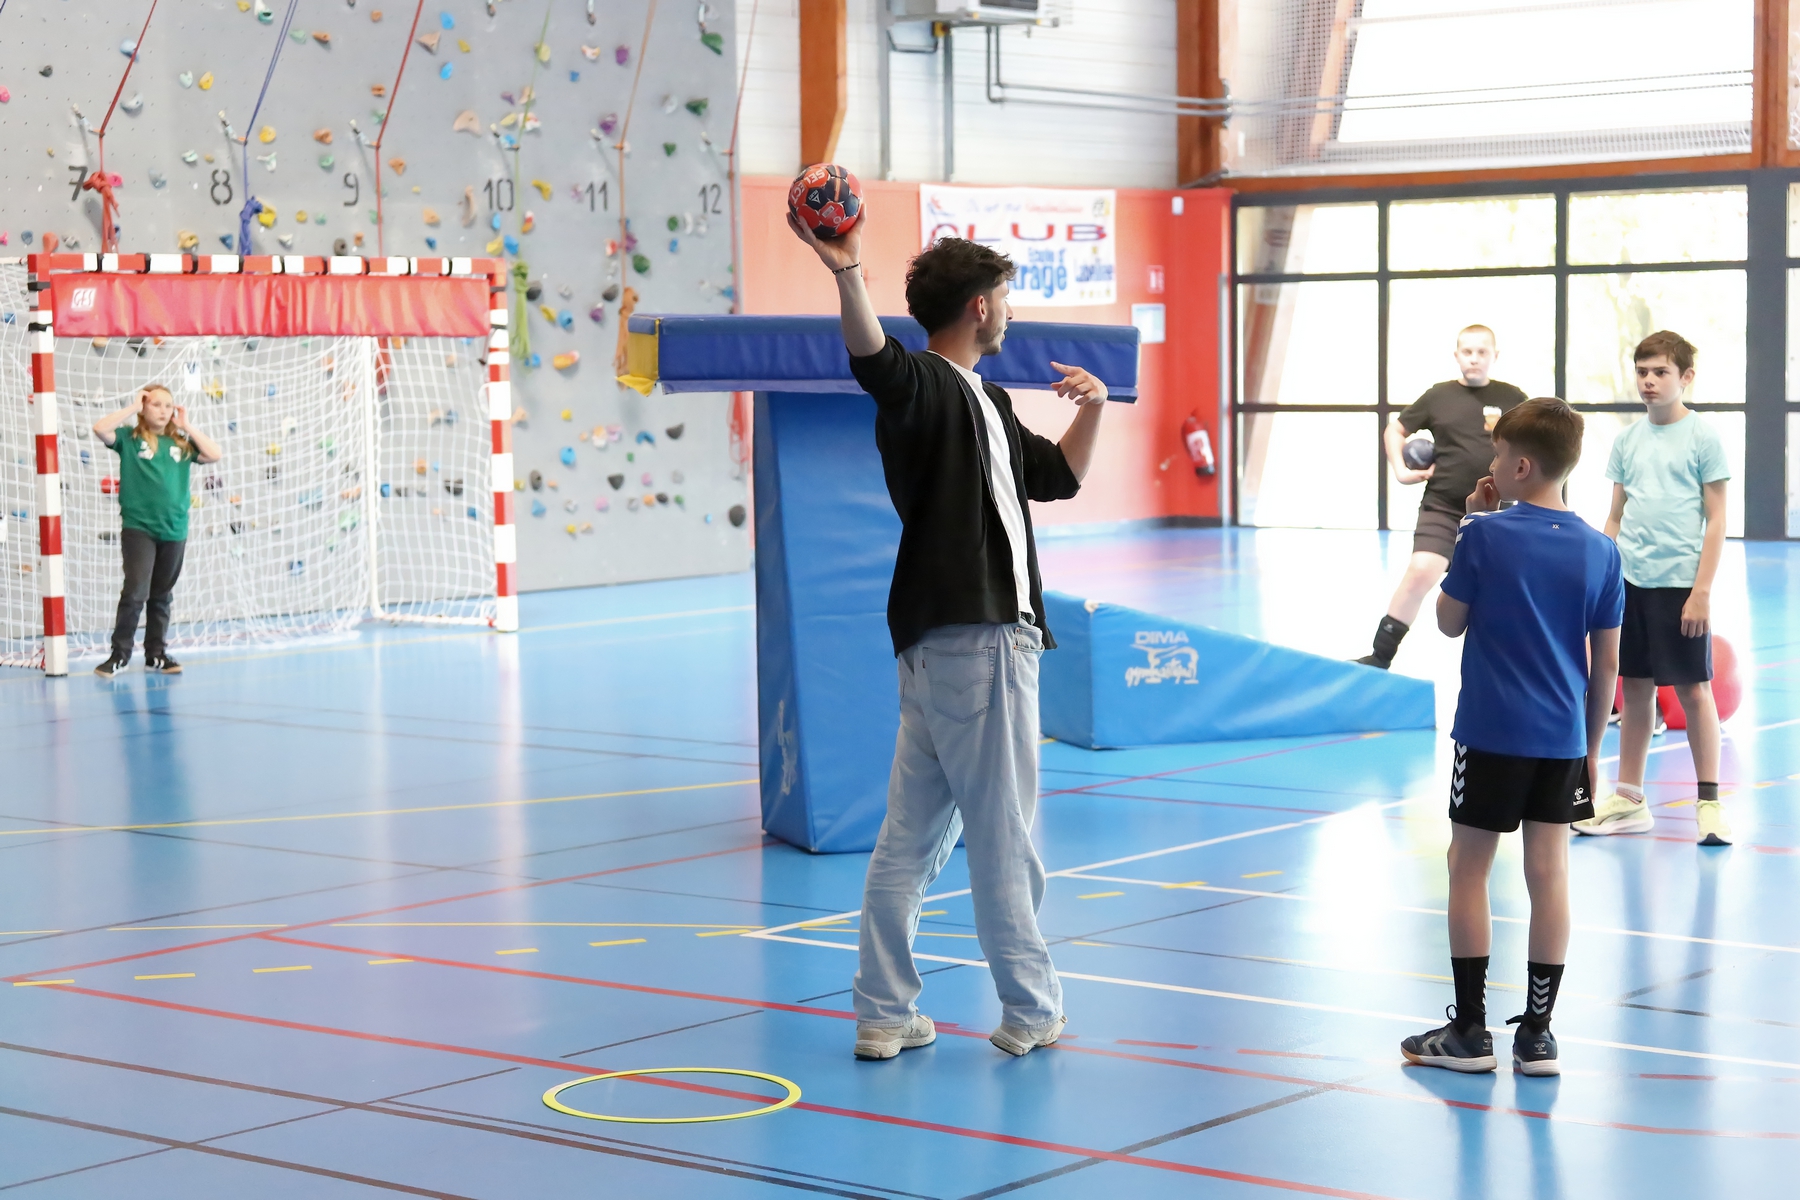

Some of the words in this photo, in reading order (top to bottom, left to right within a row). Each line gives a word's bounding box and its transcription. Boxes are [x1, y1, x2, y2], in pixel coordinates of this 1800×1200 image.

[68, 165, 89, 202] 7
[210, 168, 233, 205] 8
[343, 172, 360, 207] 9
[483, 178, 515, 211] 10
[586, 181, 609, 212] 11
[698, 183, 722, 214] 12
[1134, 630, 1189, 645] DIMA
